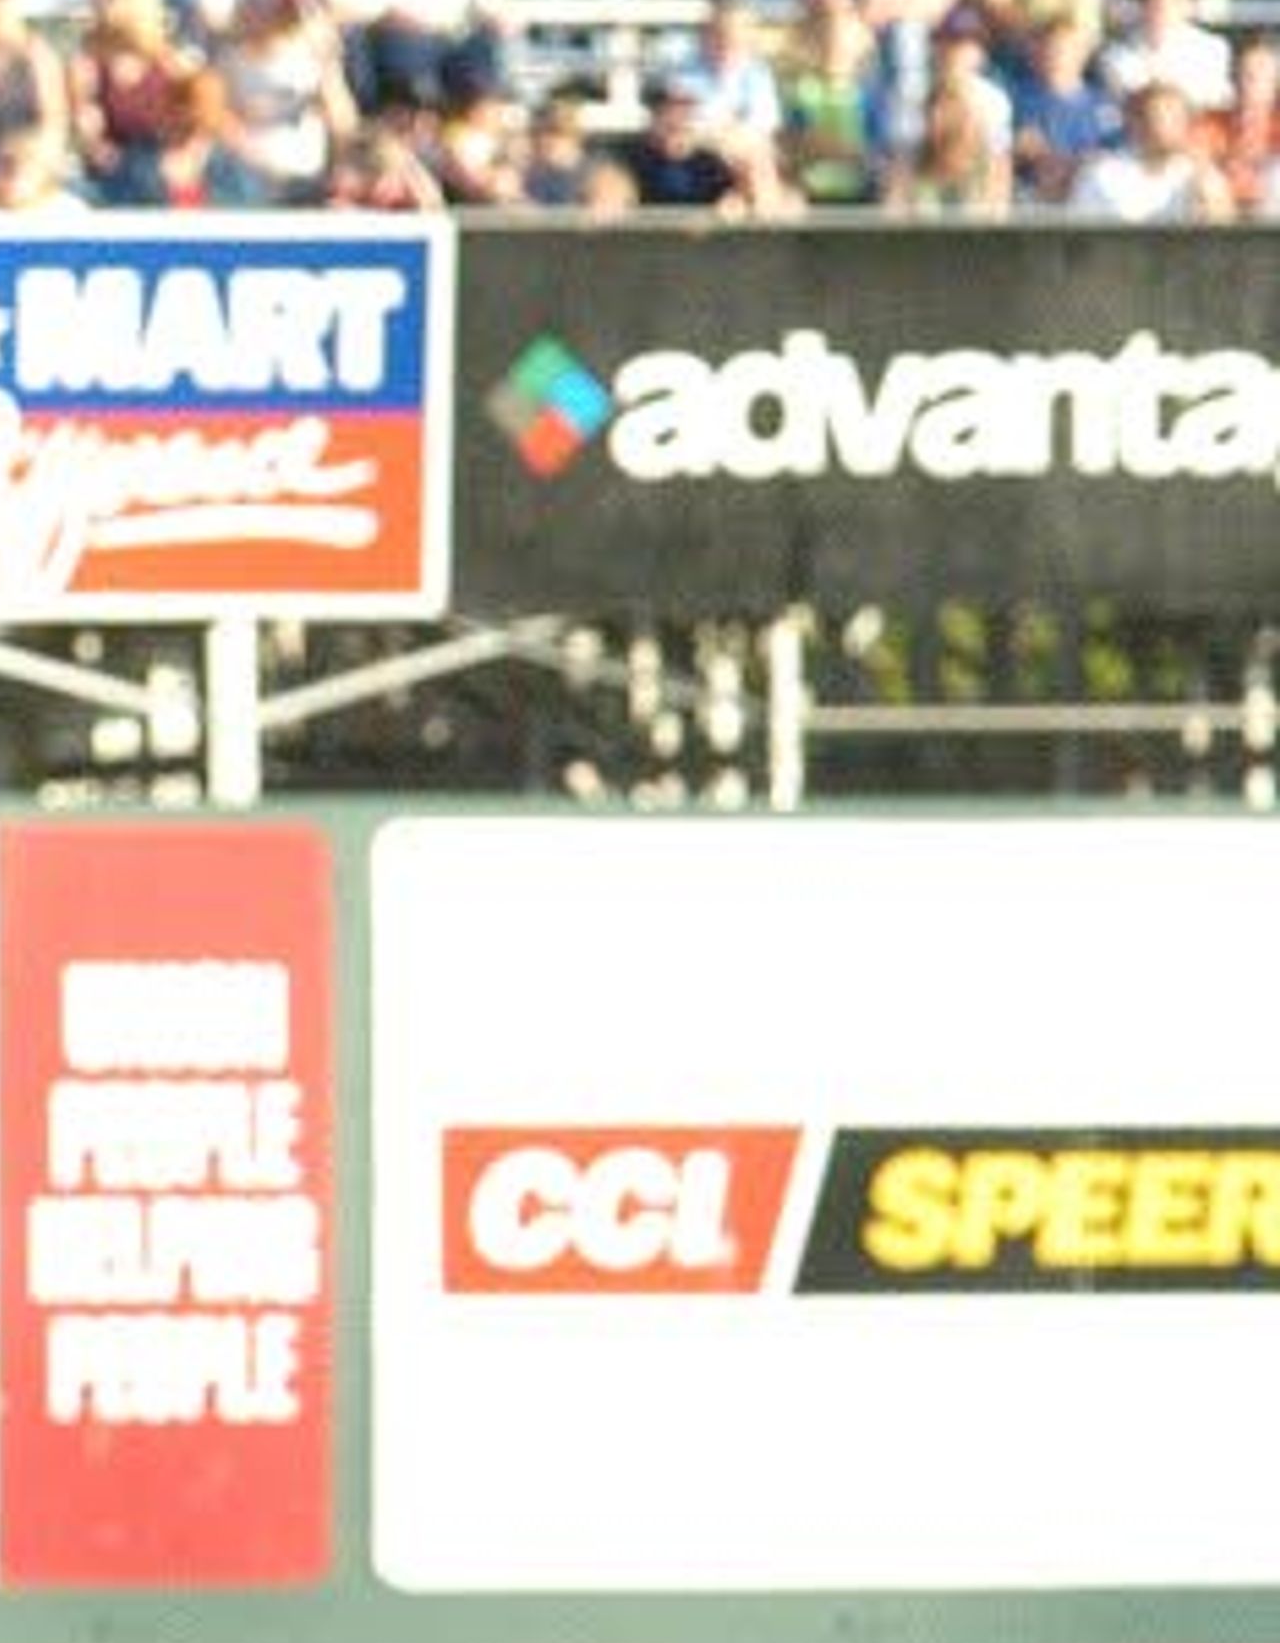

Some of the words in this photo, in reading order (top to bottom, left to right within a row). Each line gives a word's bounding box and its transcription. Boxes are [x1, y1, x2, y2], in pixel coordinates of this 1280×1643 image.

[15, 267, 406, 392] MART
[609, 329, 1280, 480] advanta
[864, 1147, 1280, 1272] SPEER
